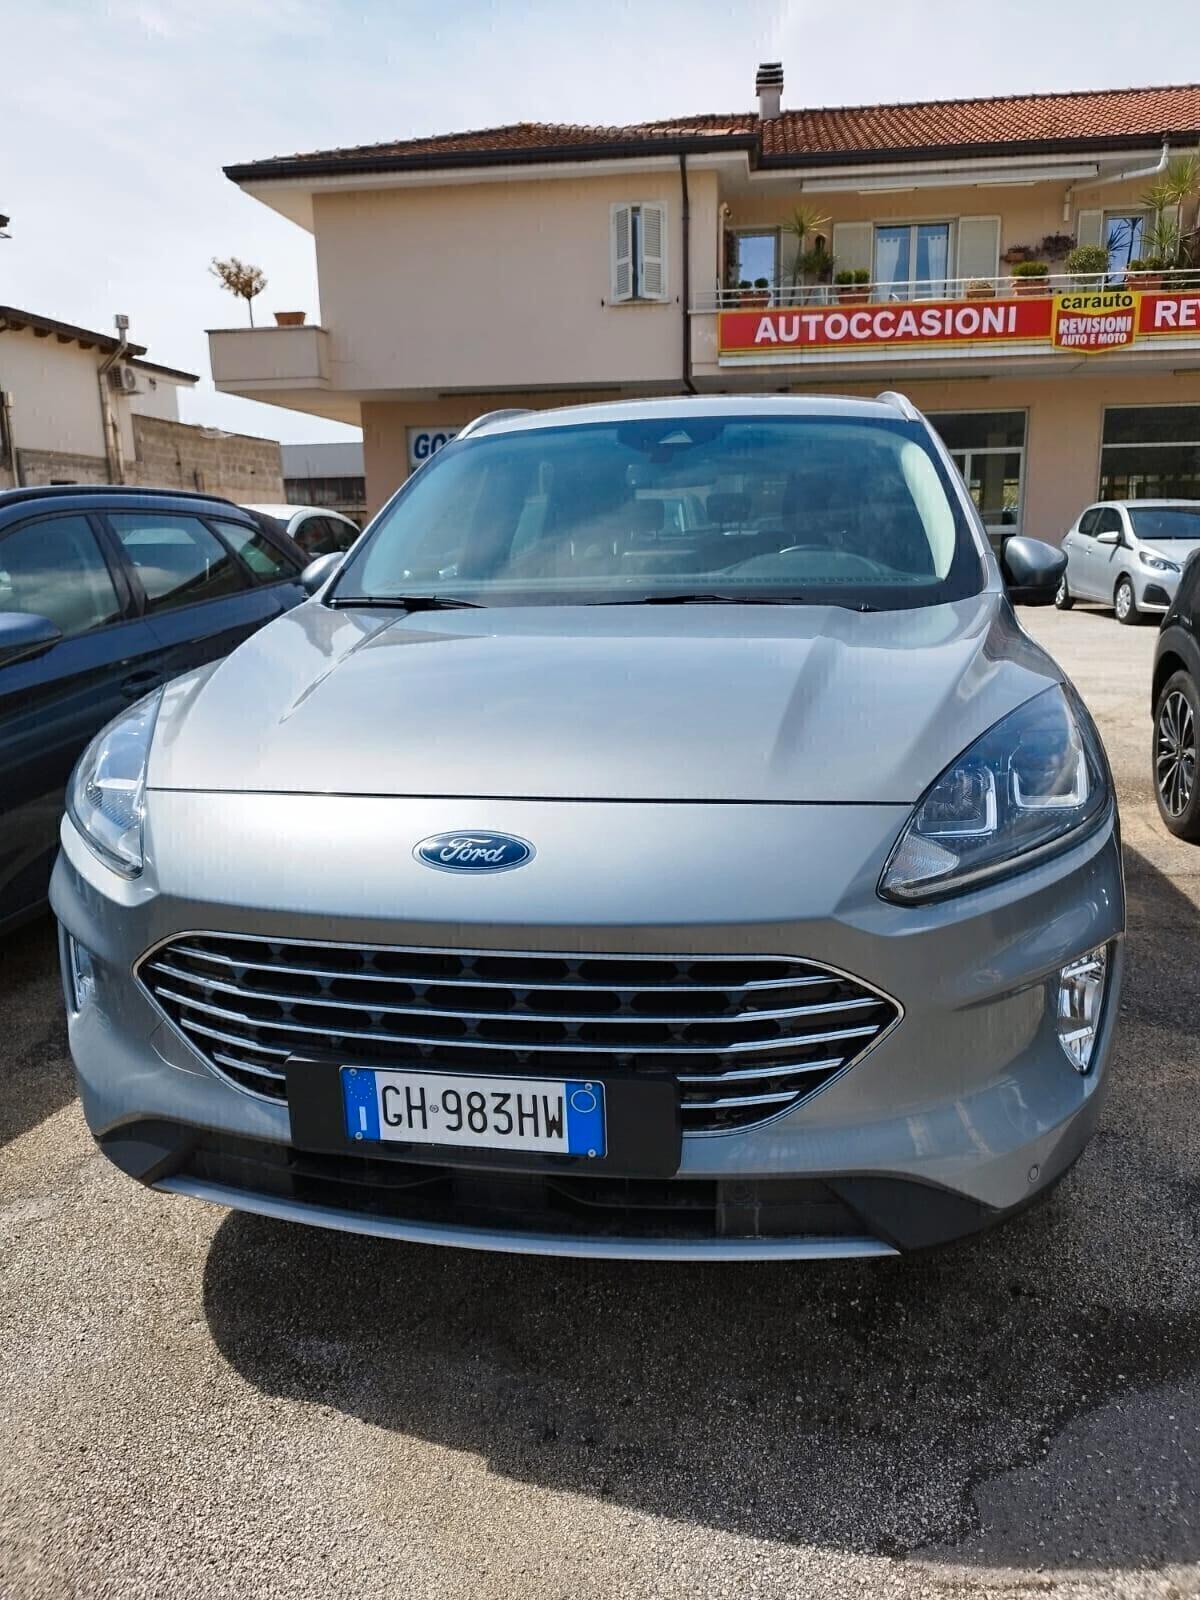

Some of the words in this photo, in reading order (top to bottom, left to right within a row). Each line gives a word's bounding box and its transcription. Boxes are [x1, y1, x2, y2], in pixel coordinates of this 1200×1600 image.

[1061, 293, 1133, 309] carauto
[1154, 298, 1200, 327] RE
[754, 306, 1017, 343] AUTOCCASIONI
[1059, 316, 1132, 334] REVISIONI
[1061, 334, 1088, 346] AUTO
[1090, 333, 1096, 344] E
[1098, 332, 1127, 344] MOTO
[414, 433, 457, 459] GO
[440, 837, 508, 862] Ford
